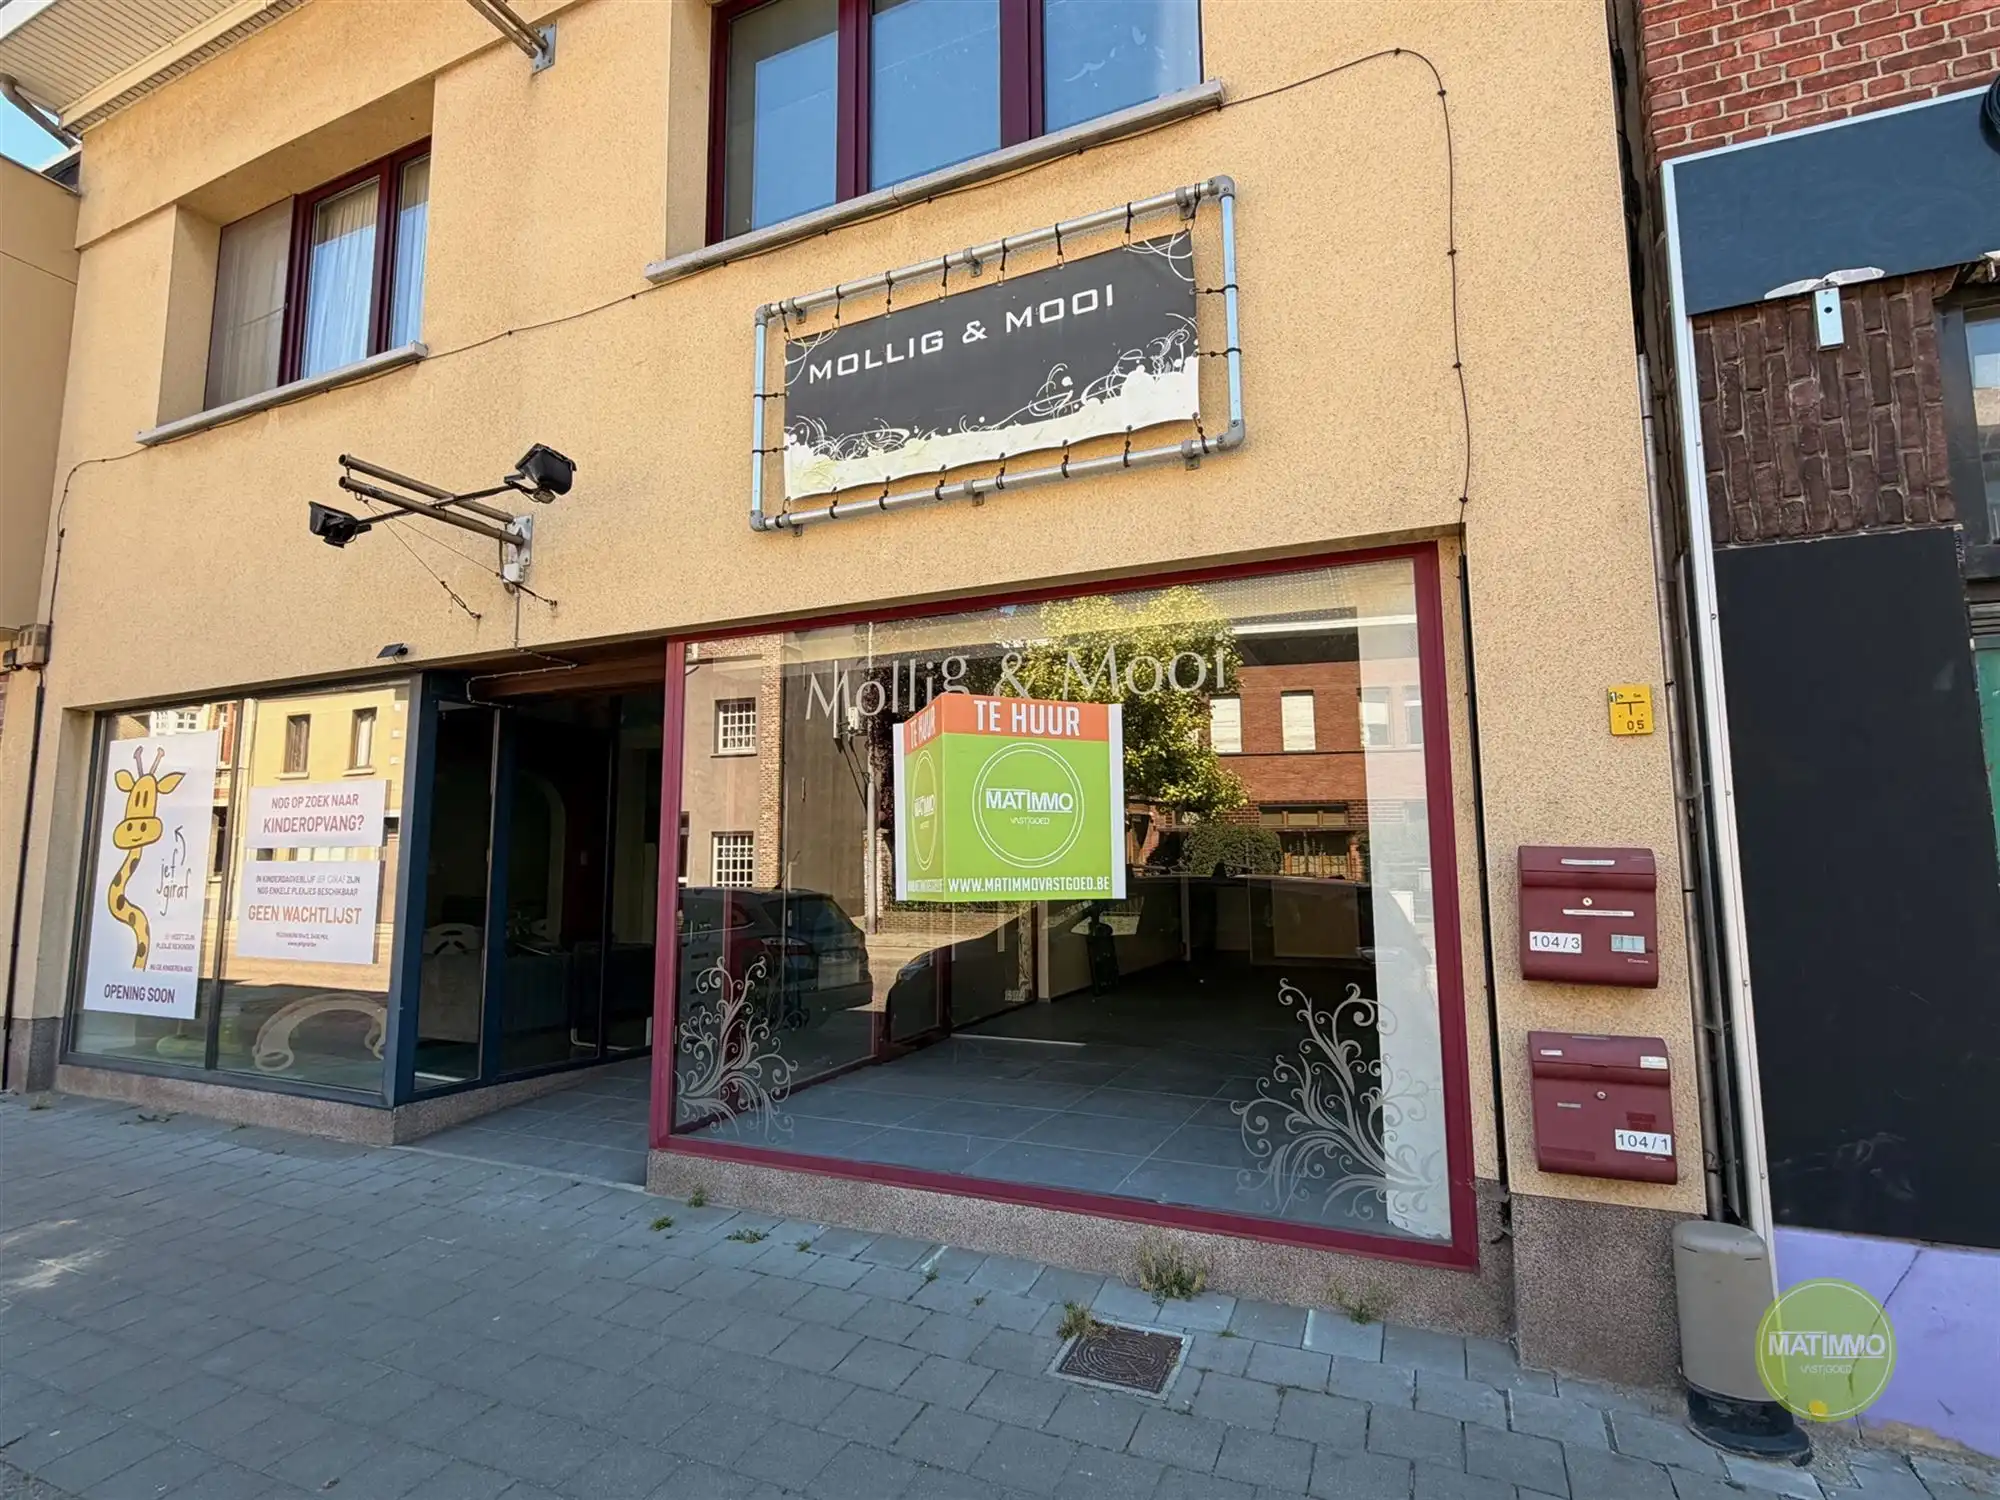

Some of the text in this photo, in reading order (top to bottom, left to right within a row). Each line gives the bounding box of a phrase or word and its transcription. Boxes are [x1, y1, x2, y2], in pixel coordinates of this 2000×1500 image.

[809, 284, 1114, 384] MOLLIG & MOOI
[805, 633, 1225, 721] Mollig & Mooi
[974, 699, 1081, 737] TE HUUR
[271, 793, 360, 809] NOG OP ZOEK NAAR
[985, 788, 1074, 813] MATIMMO
[263, 814, 365, 834] KINDEROPVANG?
[156, 848, 178, 895] jef
[160, 867, 192, 917] giraf
[948, 876, 1110, 892] WWW.MATIMMOVASTGOED.BE
[248, 905, 362, 925] GEEN WACHTLIJST
[1532, 935, 1580, 950] 104/3
[104, 983, 176, 1003] OPENING SOON
[1617, 1133, 1668, 1151] 104/1
